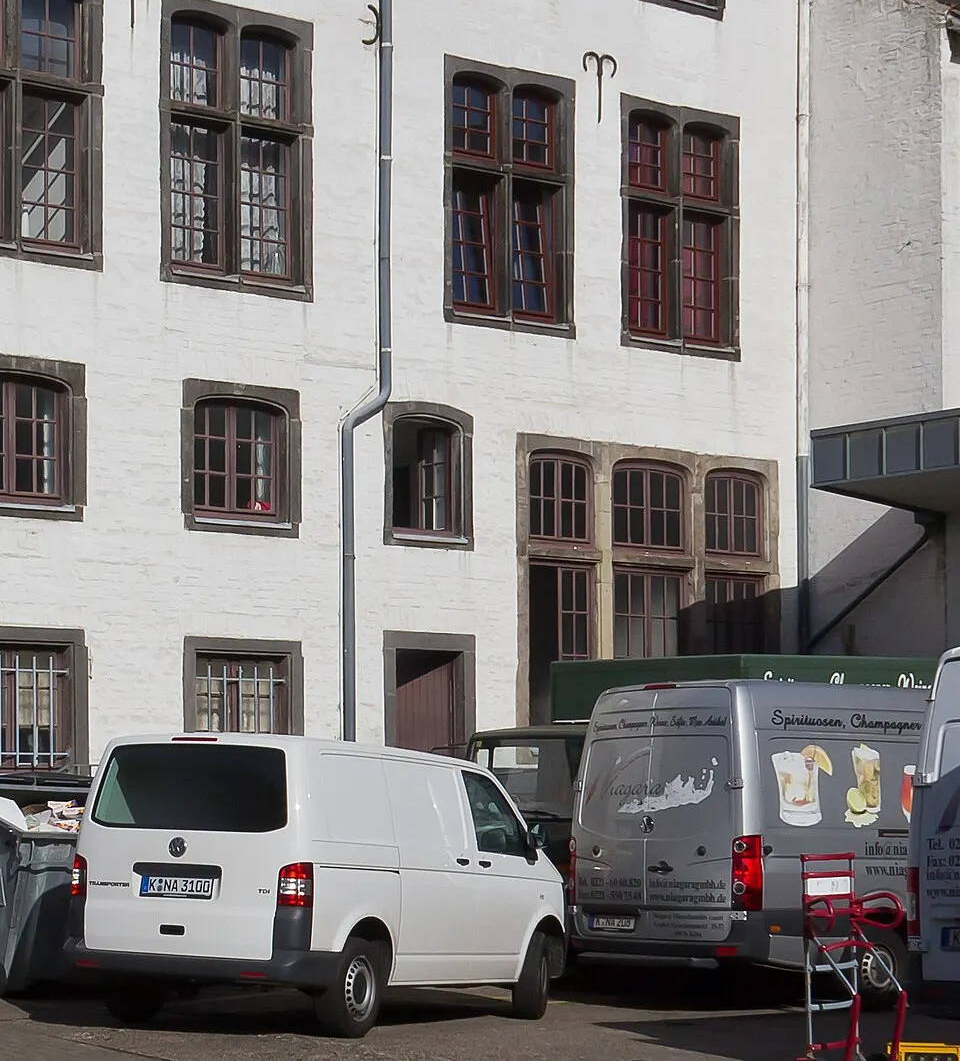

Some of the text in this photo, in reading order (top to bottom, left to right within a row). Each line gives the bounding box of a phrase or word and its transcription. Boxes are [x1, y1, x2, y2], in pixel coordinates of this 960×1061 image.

[771, 709, 922, 735] Spirituosen, Champagner
[149, 879, 211, 893] K NA 3100
